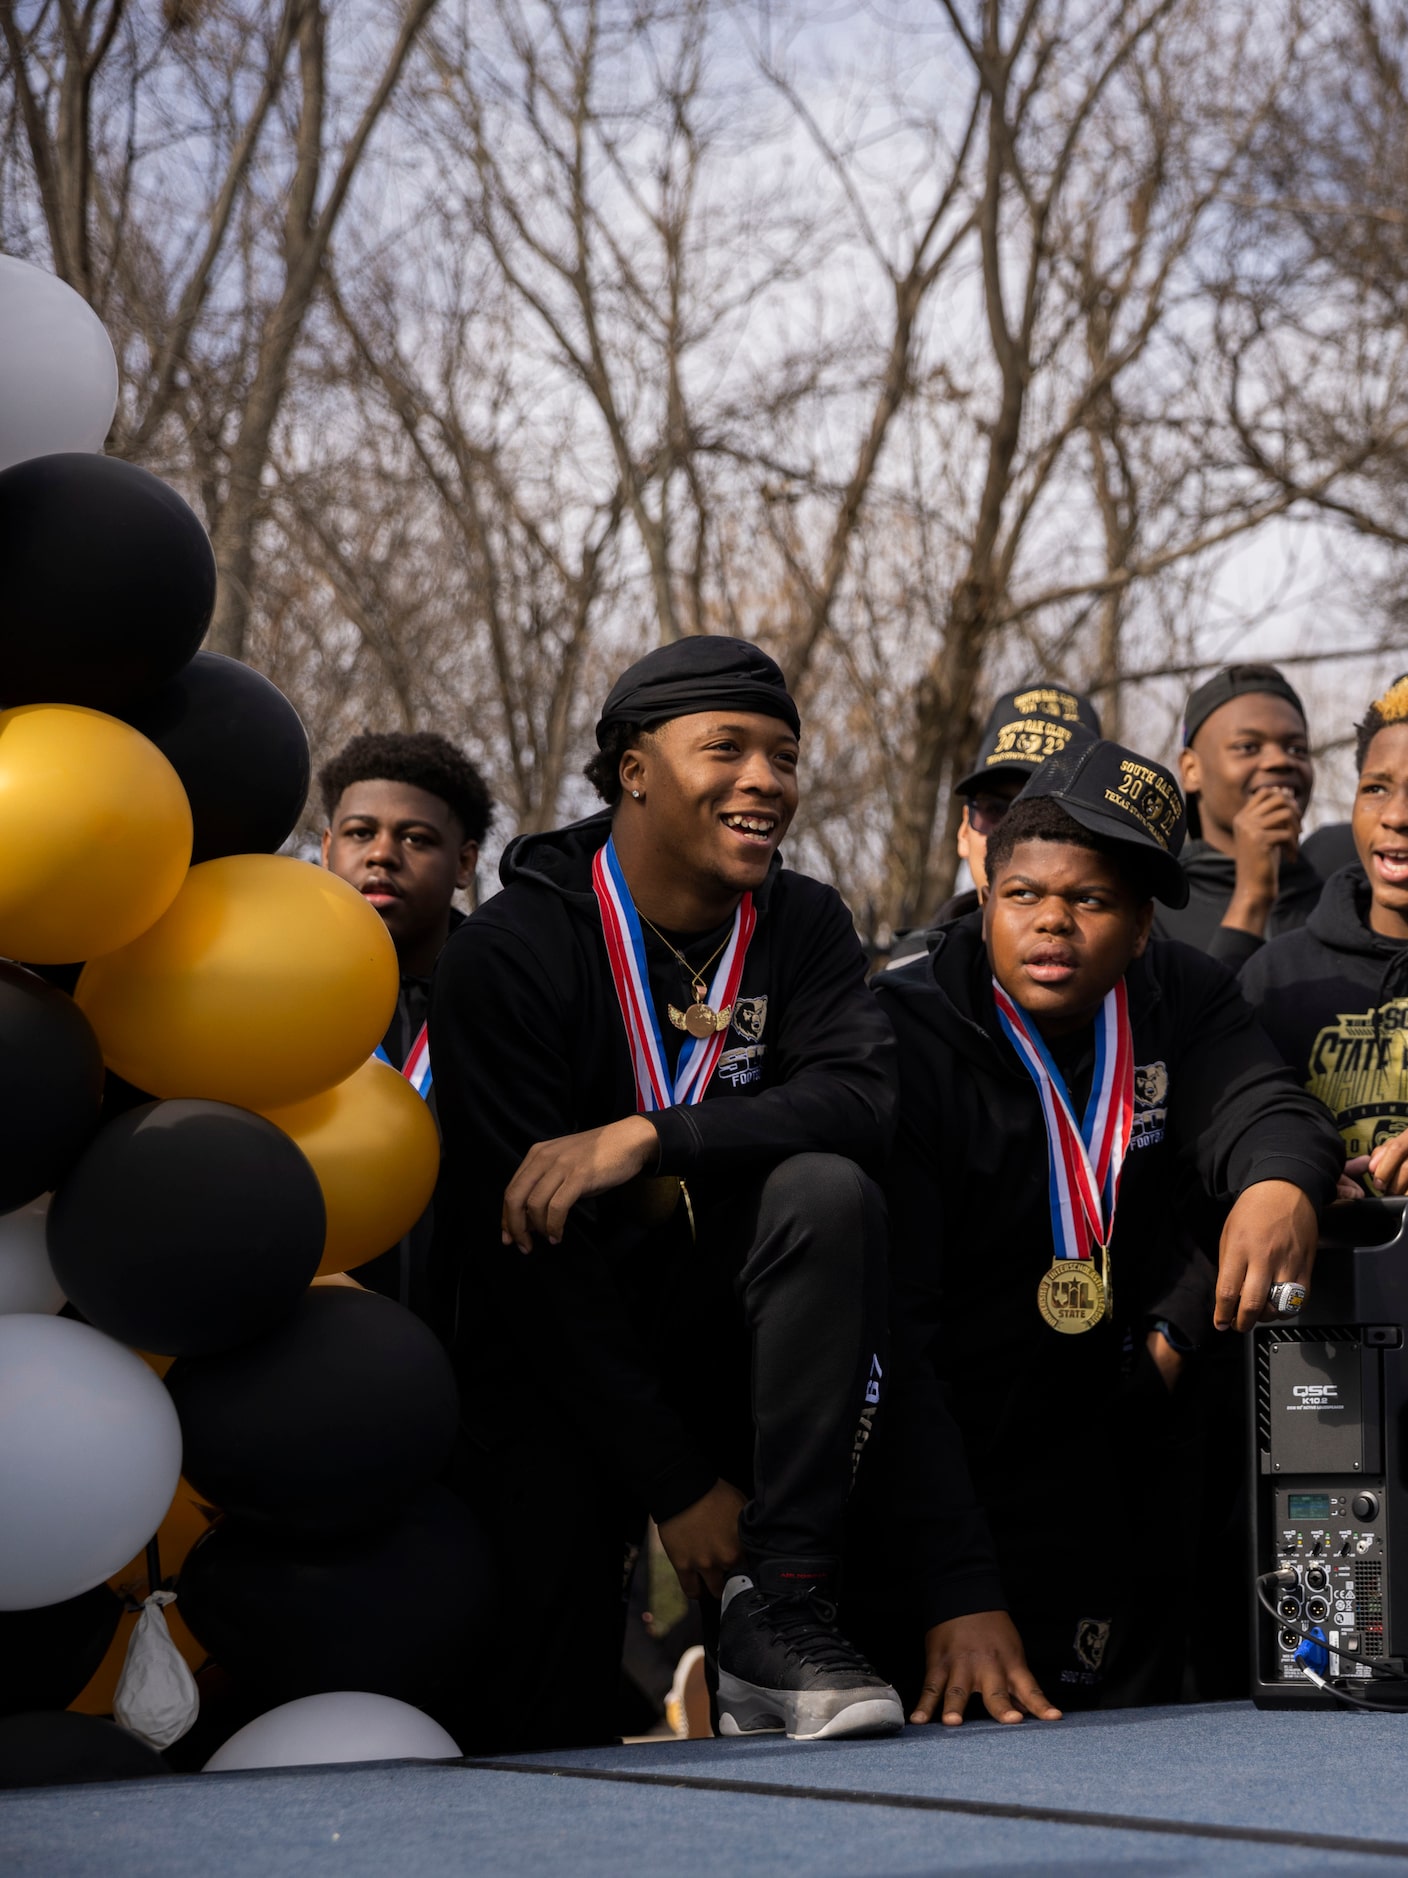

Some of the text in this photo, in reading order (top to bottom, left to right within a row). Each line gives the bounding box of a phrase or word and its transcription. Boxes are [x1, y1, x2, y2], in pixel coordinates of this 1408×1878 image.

[1024, 719, 1045, 734] OAK
[1120, 760, 1157, 785] SOUTH
[1118, 774, 1143, 800] 20
[1104, 789, 1131, 810] TEXAS
[1310, 1032, 1393, 1098] STATE
[1058, 1309, 1086, 1318] STATE
[1293, 1385, 1338, 1397] QSC
